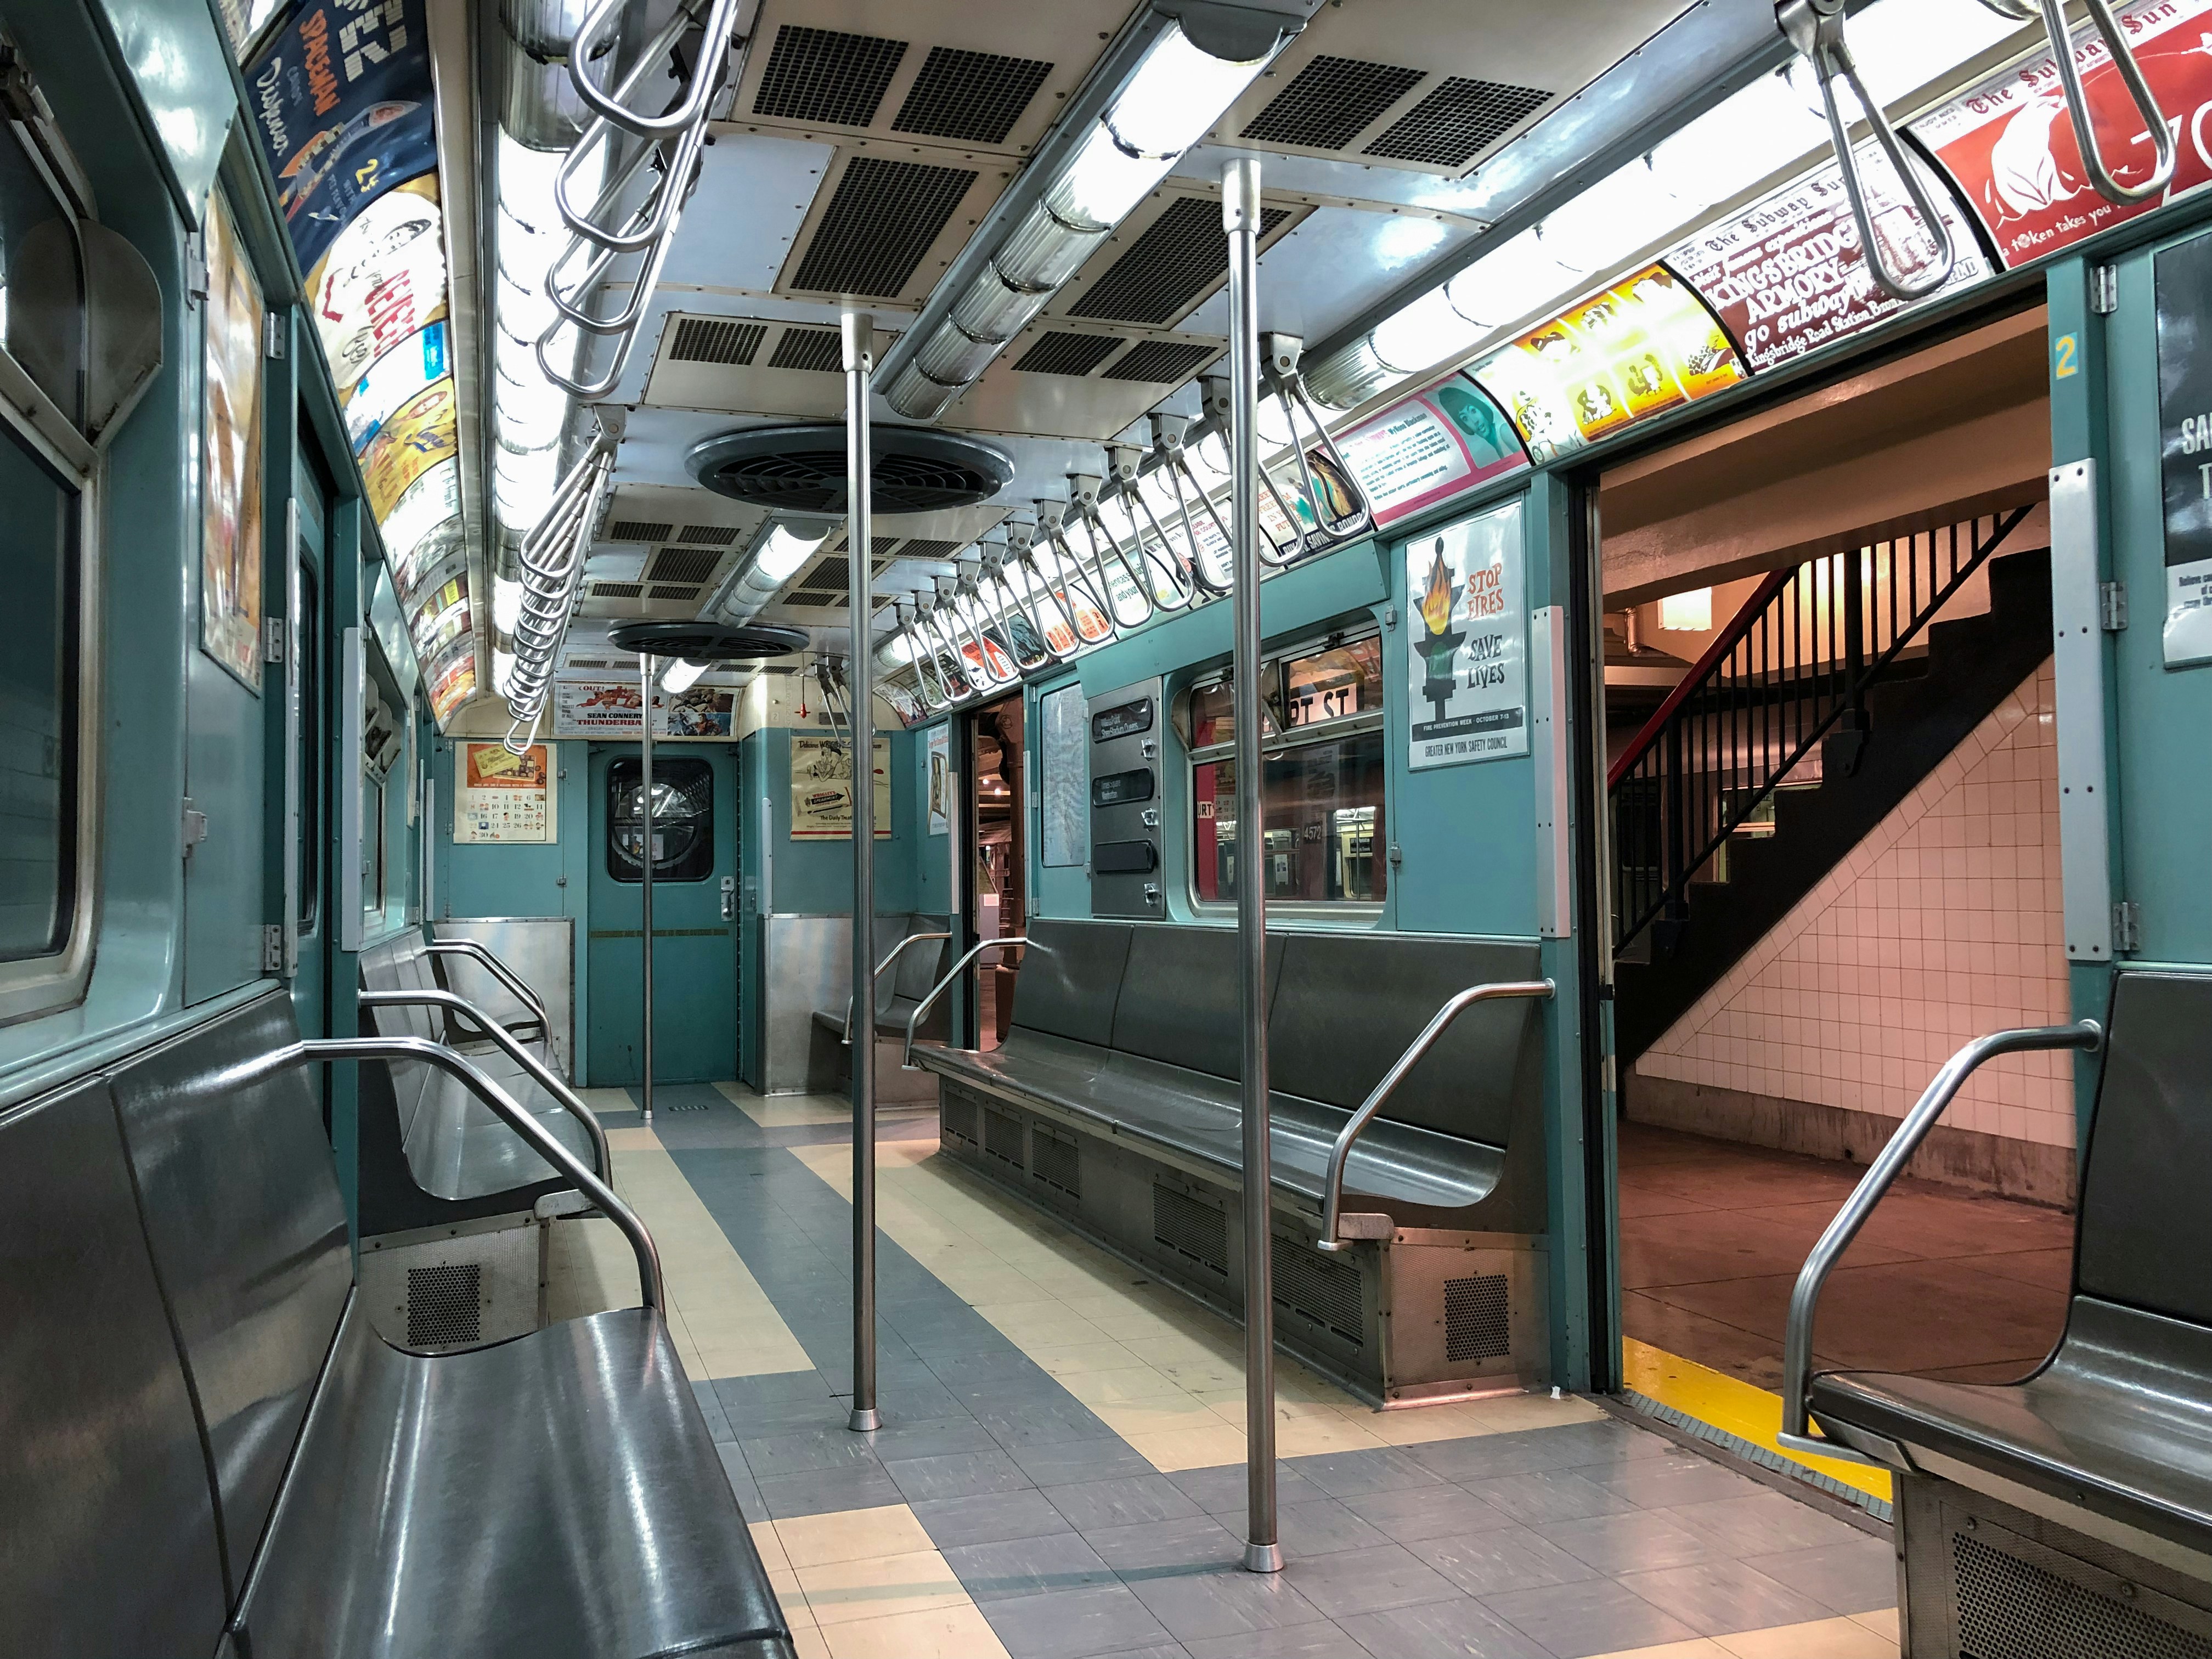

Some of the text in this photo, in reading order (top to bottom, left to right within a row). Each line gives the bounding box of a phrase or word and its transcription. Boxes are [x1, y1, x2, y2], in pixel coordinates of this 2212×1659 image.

[299, 9, 341, 116] SPACEMAN
[1967, 88, 2014, 114] The
[2121, 2, 2177, 35] Sun
[256, 57, 289, 157] Dispenser
[1705, 233, 1740, 251] The
[1741, 196, 1814, 233] Subway
[2002, 246, 2010, 257] a
[2055, 213, 2086, 233] takes
[2088, 204, 2112, 226] you
[1704, 221, 1860, 309] KINGSBRIDG
[1745, 257, 1842, 325] ARMORY
[1743, 286, 1852, 353] go subway
[1745, 332, 1808, 368] Kingsbridge
[1807, 319, 1833, 345] Road
[2055, 335, 2076, 377] 2
[1259, 492, 1292, 514] FREEM
[1191, 520, 1205, 530] LEASE
[1275, 514, 1304, 532] FUTE
[1467, 562, 1503, 595] STOP
[1466, 586, 1504, 620] FIRES
[1467, 634, 1503, 662] SAVE
[1466, 662, 1505, 690] LIVES
[1323, 687, 1349, 719] ST
[1433, 721, 1458, 730] PREVENTION
[1476, 714, 1499, 724] OCTOBER
[1425, 736, 1508, 758] GREATER NEW YORK SAFETY COUNCIL
[814, 795, 839, 804] SPEARMINT
[1304, 825, 1322, 841] 4572
